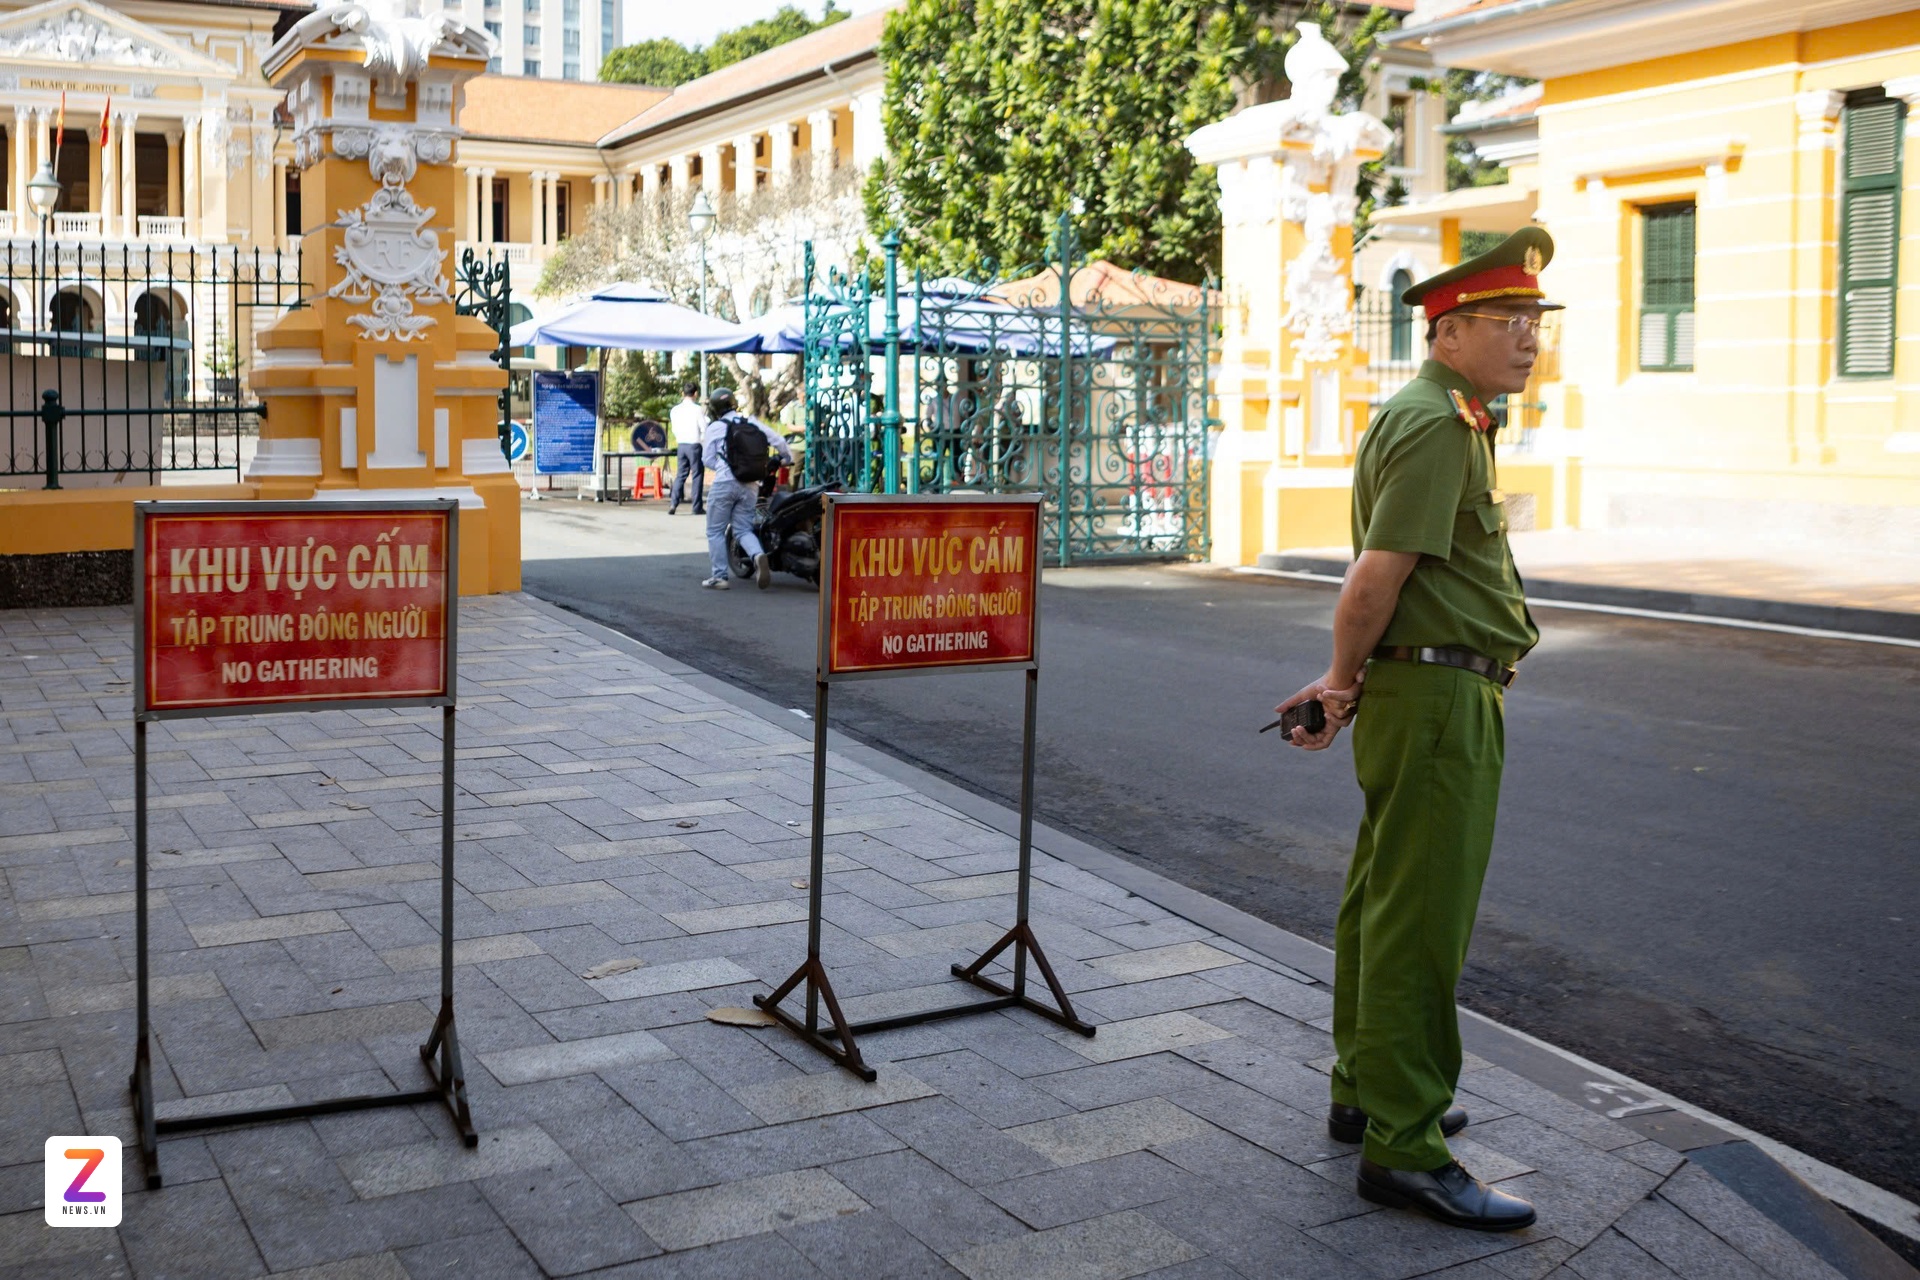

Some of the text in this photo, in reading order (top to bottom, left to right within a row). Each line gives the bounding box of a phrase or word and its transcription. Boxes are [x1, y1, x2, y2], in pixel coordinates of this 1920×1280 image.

[66, 81, 76, 90] DE
[170, 526, 429, 600] KHU VỰC CẤM
[850, 521, 1024, 584] KHU VỰC CẤM
[849, 586, 1022, 627] TẬP TRUNG ĐÔNG NGƯỜI
[170, 603, 428, 652] TẬP TRUNG ĐÔNG NGƯỜI
[882, 630, 988, 655] NO GATHERING
[222, 656, 379, 685] NO GATHERING
